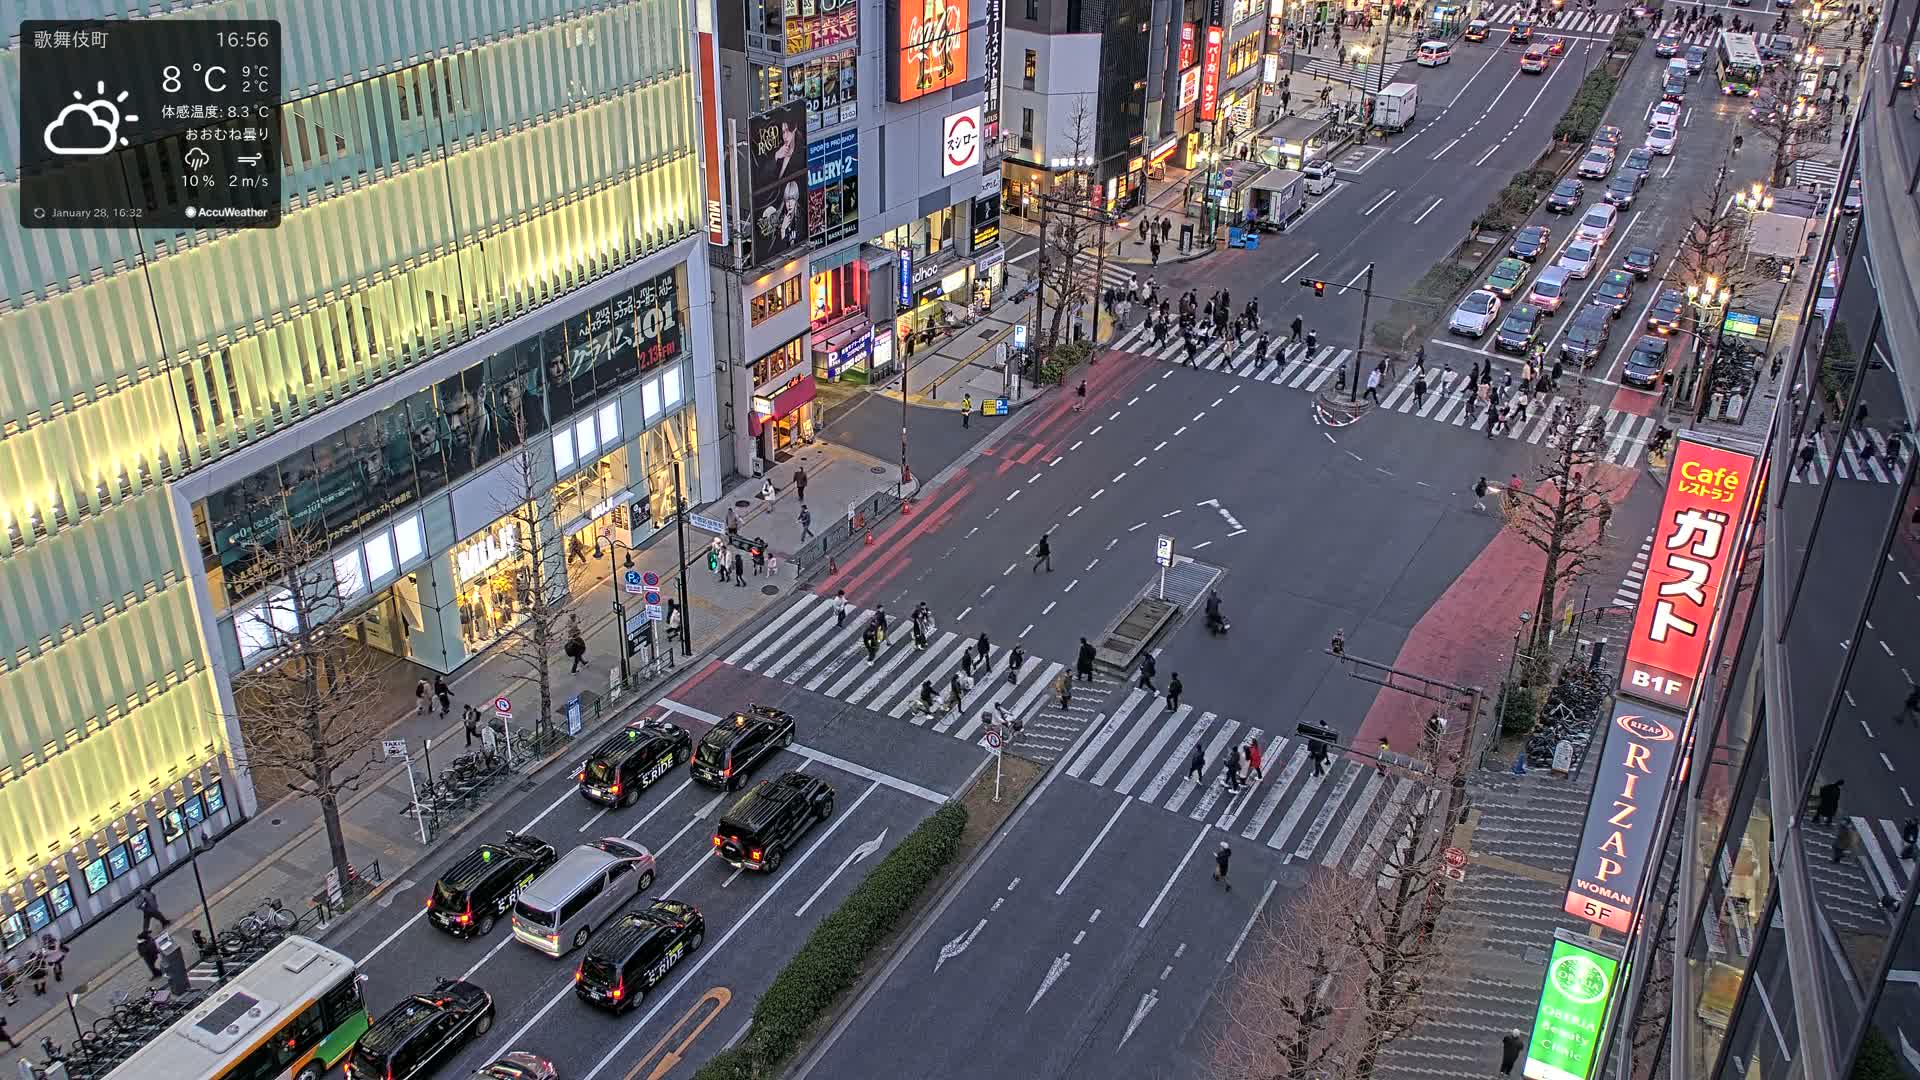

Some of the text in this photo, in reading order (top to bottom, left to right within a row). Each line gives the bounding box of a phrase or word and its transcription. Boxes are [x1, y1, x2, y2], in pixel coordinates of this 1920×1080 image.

[1204, 46, 1219, 111] バーガーキング
[947, 133, 978, 150] スシロー
[708, 199, 722, 233] MUJI
[1681, 461, 1739, 490] Café
[1678, 480, 1735, 503] レストラン
[1648, 507, 1729, 644] ガスト
[1631, 669, 1683, 695] B1F
[1630, 720, 1662, 736] RIZAP
[1594, 741, 1653, 882] RIZAP
[1576, 878, 1633, 905] WOMAN
[1584, 902, 1612, 920] 5F
[1542, 1020, 1589, 1047] Beauty
[1540, 1039, 1583, 1062] Clinic
